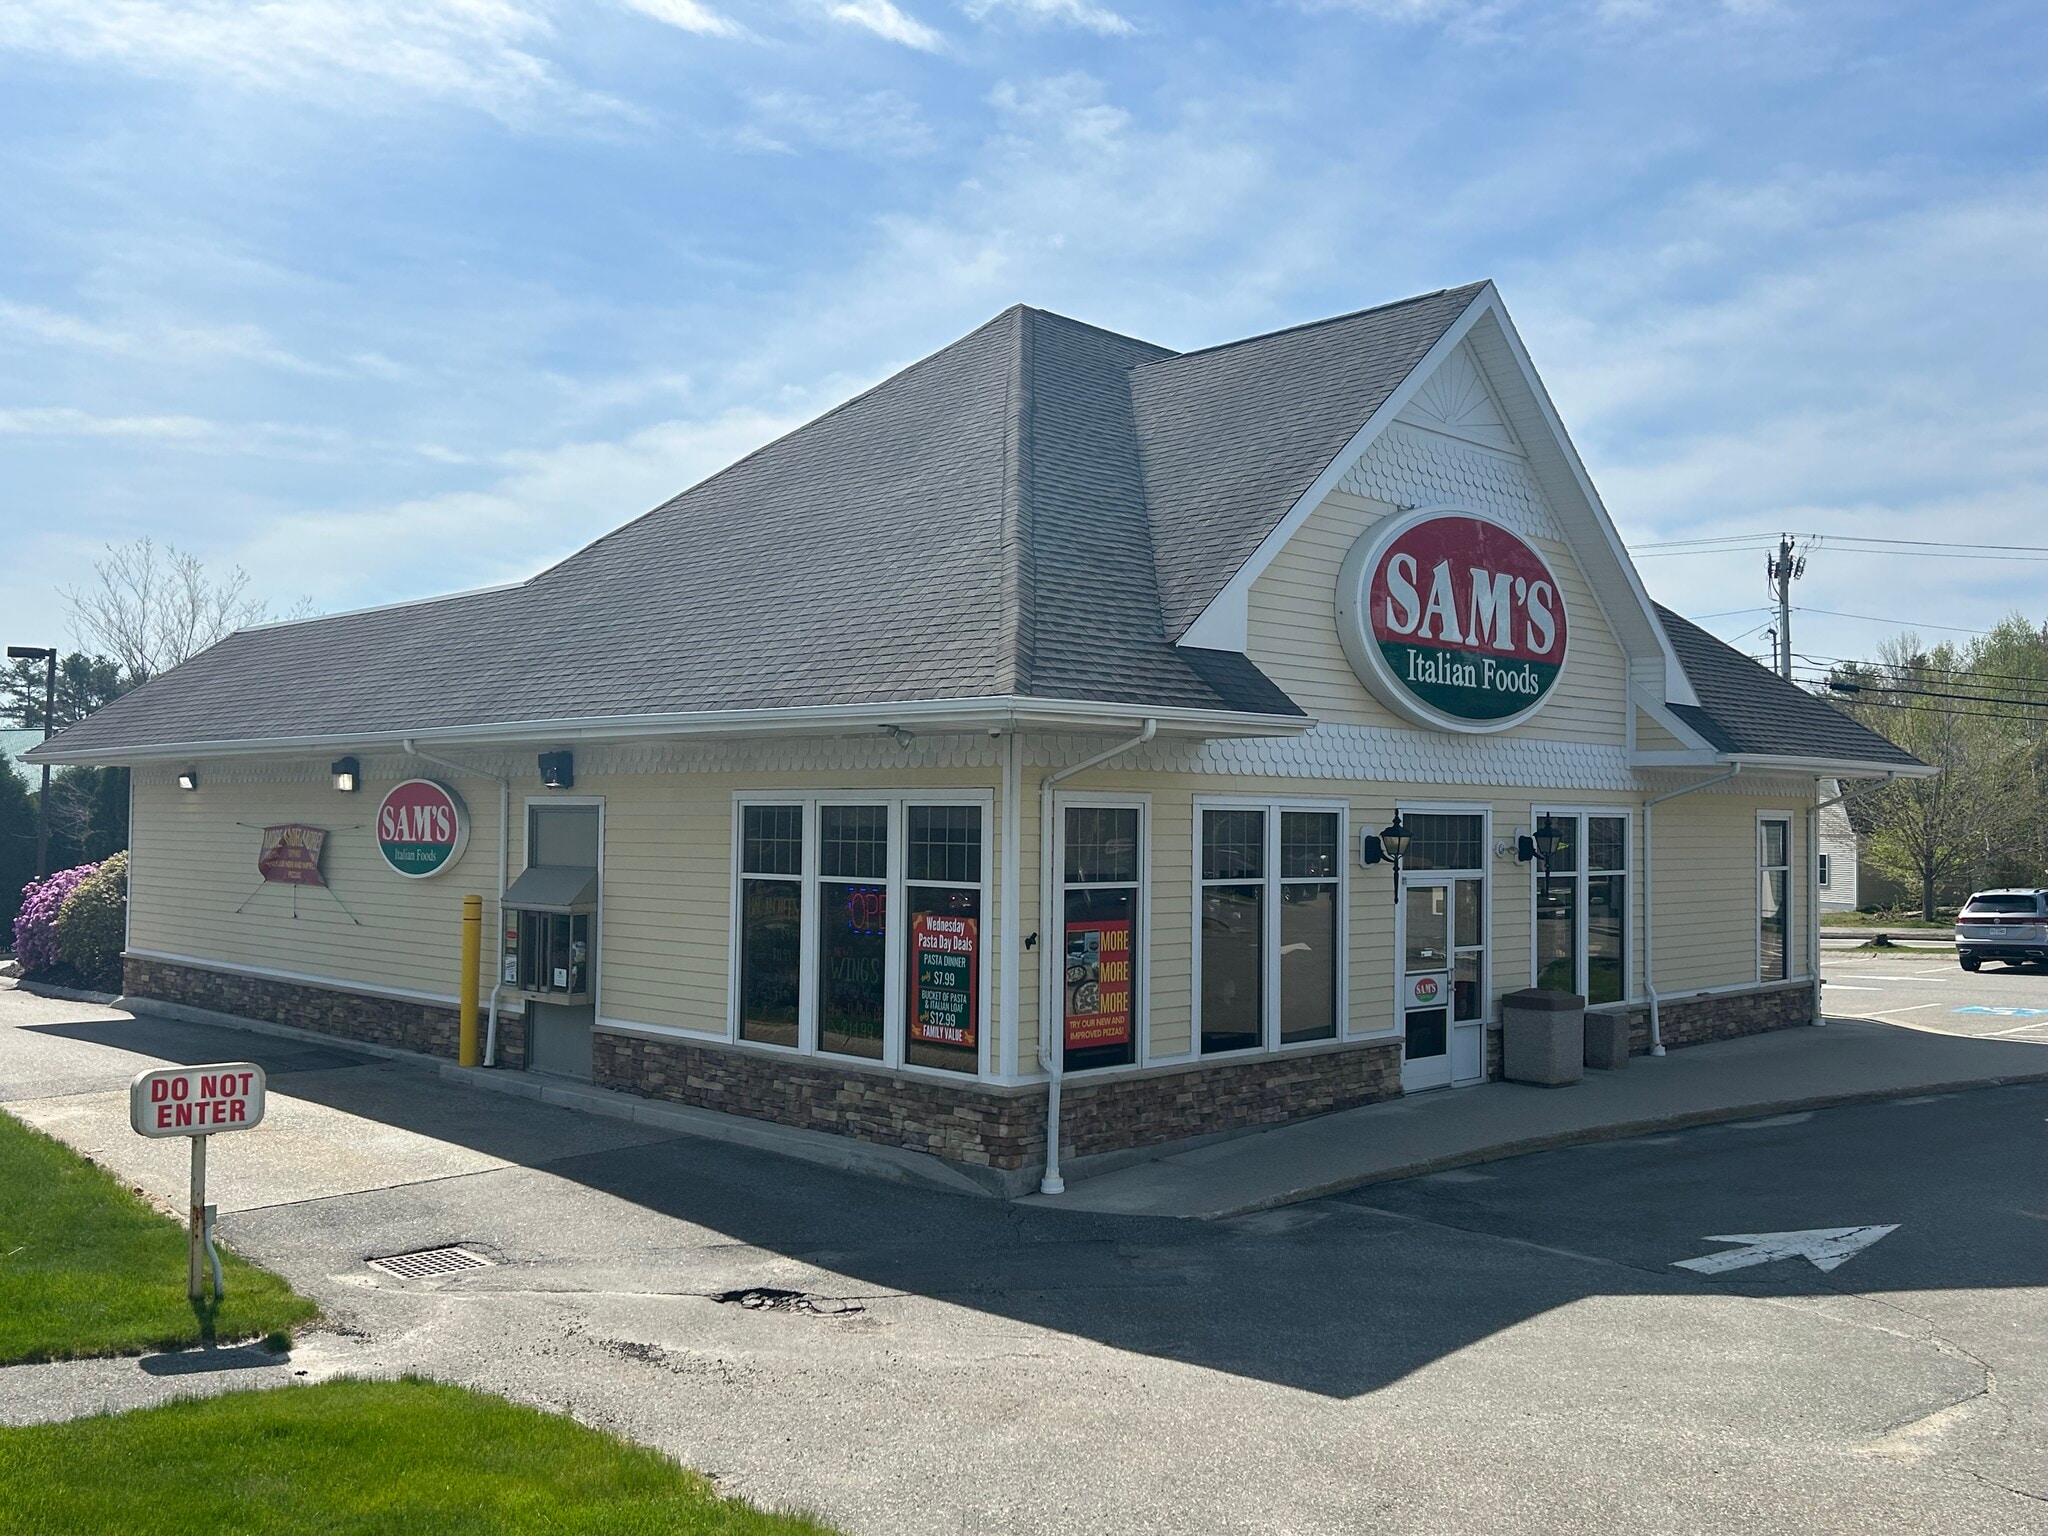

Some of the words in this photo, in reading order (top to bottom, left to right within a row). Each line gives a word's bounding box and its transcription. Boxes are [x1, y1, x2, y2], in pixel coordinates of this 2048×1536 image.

[1387, 553, 1556, 655] SAM'S
[1407, 649, 1477, 688] Italian
[1482, 658, 1539, 694] Foods
[382, 805, 450, 842] SAM'S
[395, 848, 415, 861] Italian
[416, 849, 437, 862] Foods
[852, 893, 887, 930] OPE
[926, 916, 965, 936] Wednesday
[918, 933, 938, 948] Pasta
[939, 935, 952, 953] Day
[953, 936, 973, 951] Deals
[1100, 930, 1128, 951] MORE
[830, 957, 880, 984] WINGS
[923, 954, 942, 966] PASTA
[943, 956, 966, 968] DINNER
[933, 971, 955, 986] $7.99
[1100, 961, 1128, 982] MORE
[922, 990, 941, 1001] BUCKET
[942, 992, 949, 1001] OF
[950, 993, 967, 1004] PASTA
[930, 1000, 949, 1011] ITALIAN
[950, 1002, 963, 1013] LOAF
[1100, 991, 1128, 1014] MORE
[930, 1011, 956, 1026] $12.99
[1070, 1020, 1081, 1029] TRY
[1082, 1018, 1096, 1028] OUR
[1096, 1017, 1111, 1026] NEW
[1112, 1016, 1125, 1025] AND
[923, 1025, 944, 1039] FAMILY
[944, 1028, 963, 1042] VALUE
[1070, 1030, 1101, 1040] IMPROVED
[151, 1077, 189, 1102] DO
[200, 1073, 254, 1098] NOT
[157, 1099, 246, 1129] ENTER
